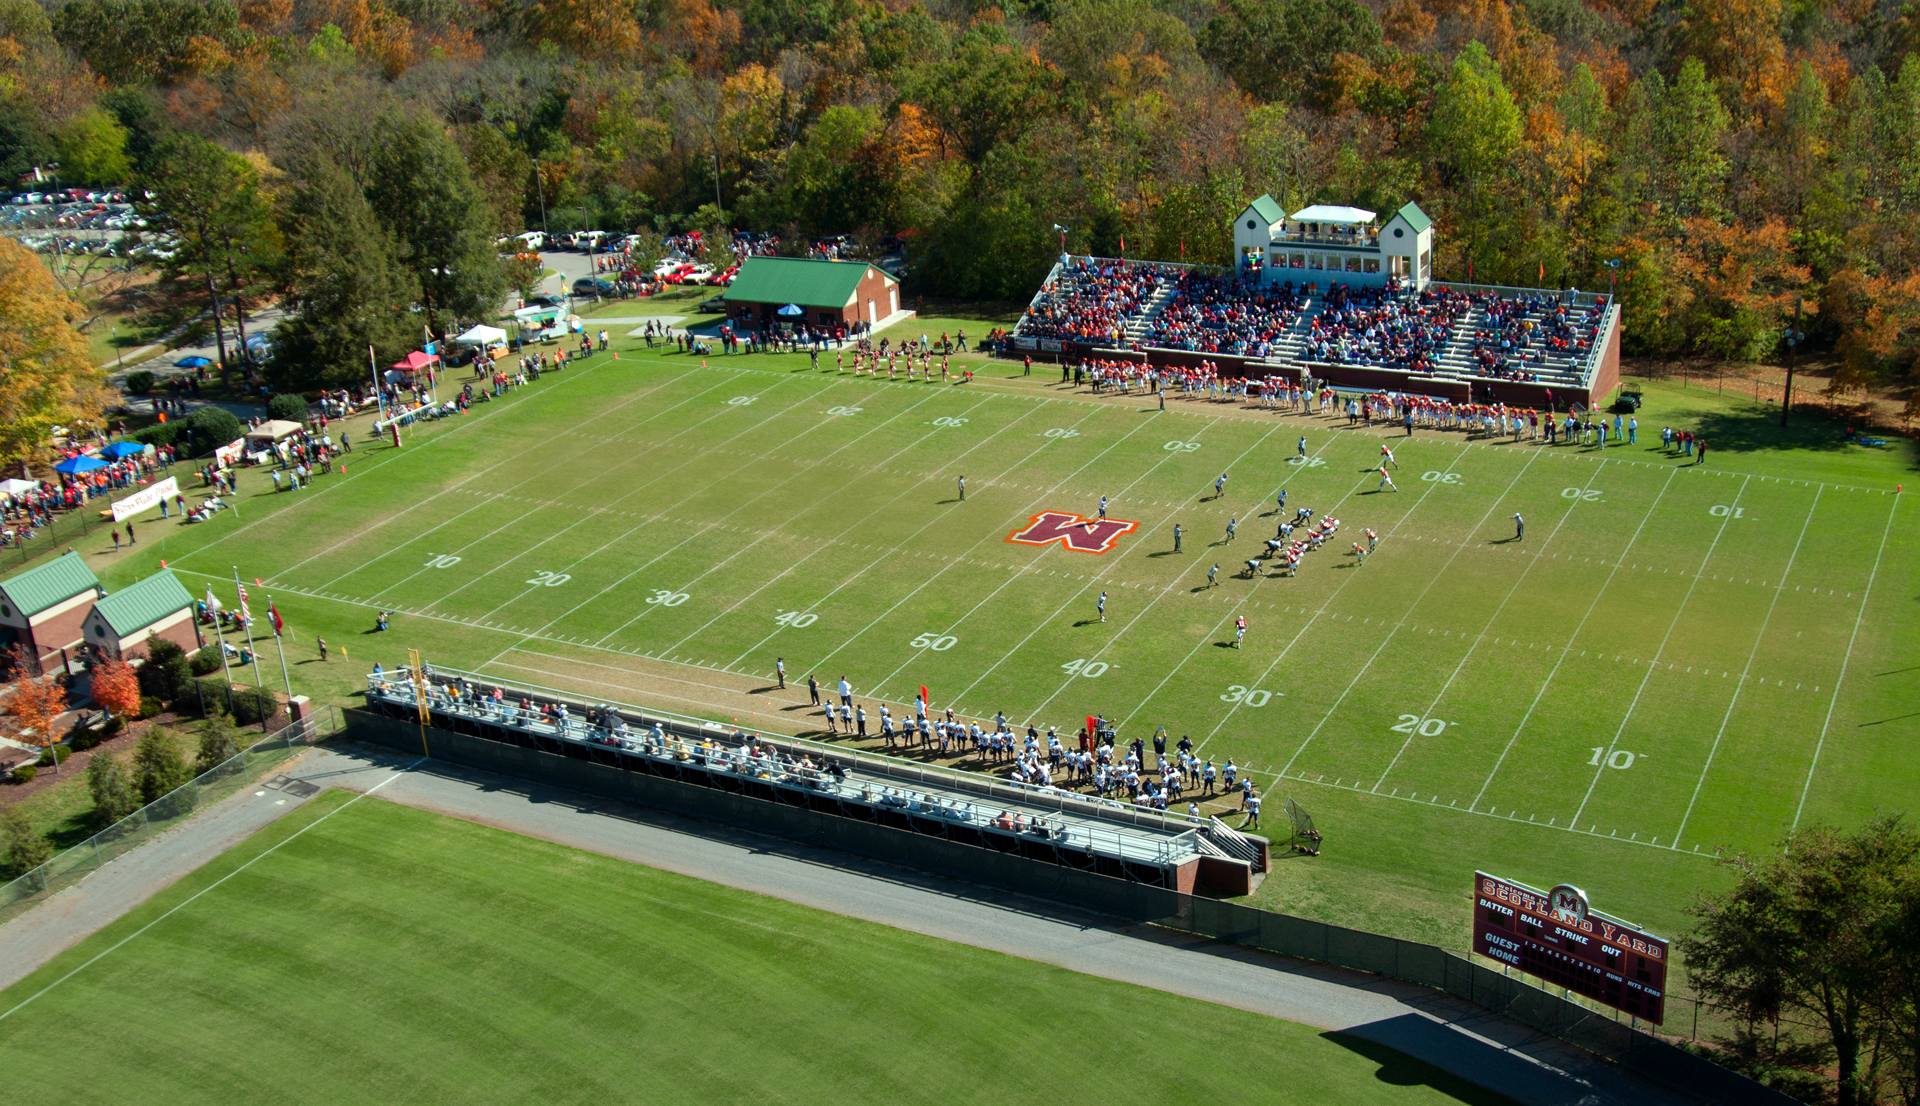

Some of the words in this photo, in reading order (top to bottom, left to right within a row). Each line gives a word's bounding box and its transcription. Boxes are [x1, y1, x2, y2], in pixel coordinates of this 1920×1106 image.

[423, 554, 461, 569] 10
[525, 570, 571, 587] 20
[645, 590, 690, 607] 30
[774, 610, 819, 628] 40
[910, 632, 958, 651] 50
[1060, 658, 1109, 678] 40
[1219, 685, 1273, 708] 30
[1390, 713, 1447, 737] 20
[1586, 746, 1635, 770] 10
[1480, 898, 1514, 917] BATTER
[1557, 891, 1580, 915] M
[1482, 878, 1593, 932] SCOTLAND
[1601, 921, 1662, 958] YARD
[1520, 913, 1543, 928] BALL
[1485, 932, 1520, 952] GUEST
[1554, 927, 1589, 945] STRIKE
[1488, 946, 1520, 965] HOME
[1601, 944, 1622, 957] OUT
[1606, 972, 1623, 982] RUNS
[1627, 980, 1642, 990] HITS
